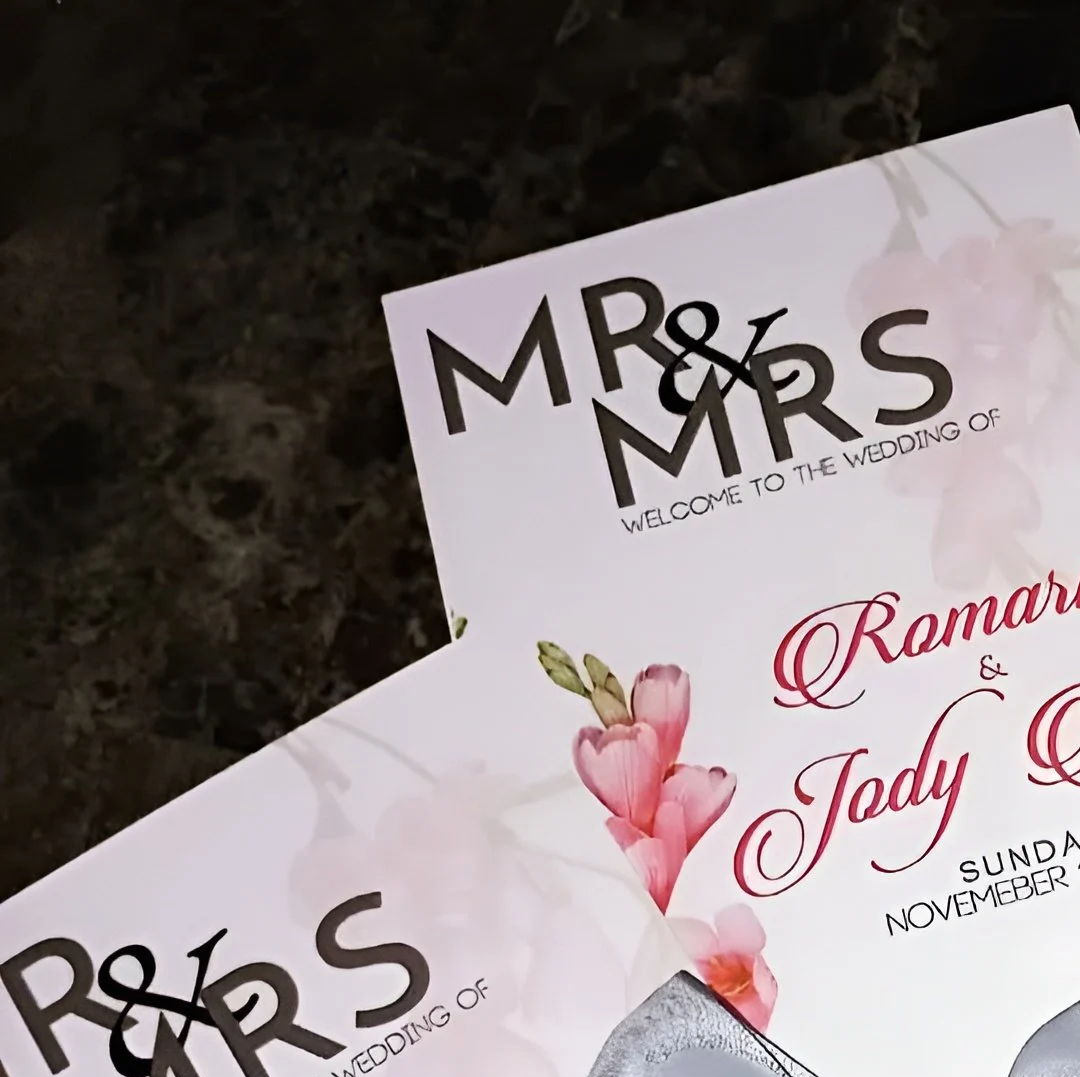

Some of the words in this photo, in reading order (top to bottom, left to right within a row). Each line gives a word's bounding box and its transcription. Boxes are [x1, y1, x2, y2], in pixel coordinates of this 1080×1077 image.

[426, 276, 692, 435] MR
[591, 308, 954, 508] MRS
[621, 484, 743, 534] WELCOME
[749, 472, 786, 499] TO
[793, 457, 837, 485] THE
[842, 420, 961, 473] WEDDING
[968, 407, 1001, 433] OF
[979, 655, 1009, 681] &
[733, 687, 1005, 898] Jody
[885, 871, 1070, 937] NOVEMEBER
[455, 978, 489, 1012] OF
